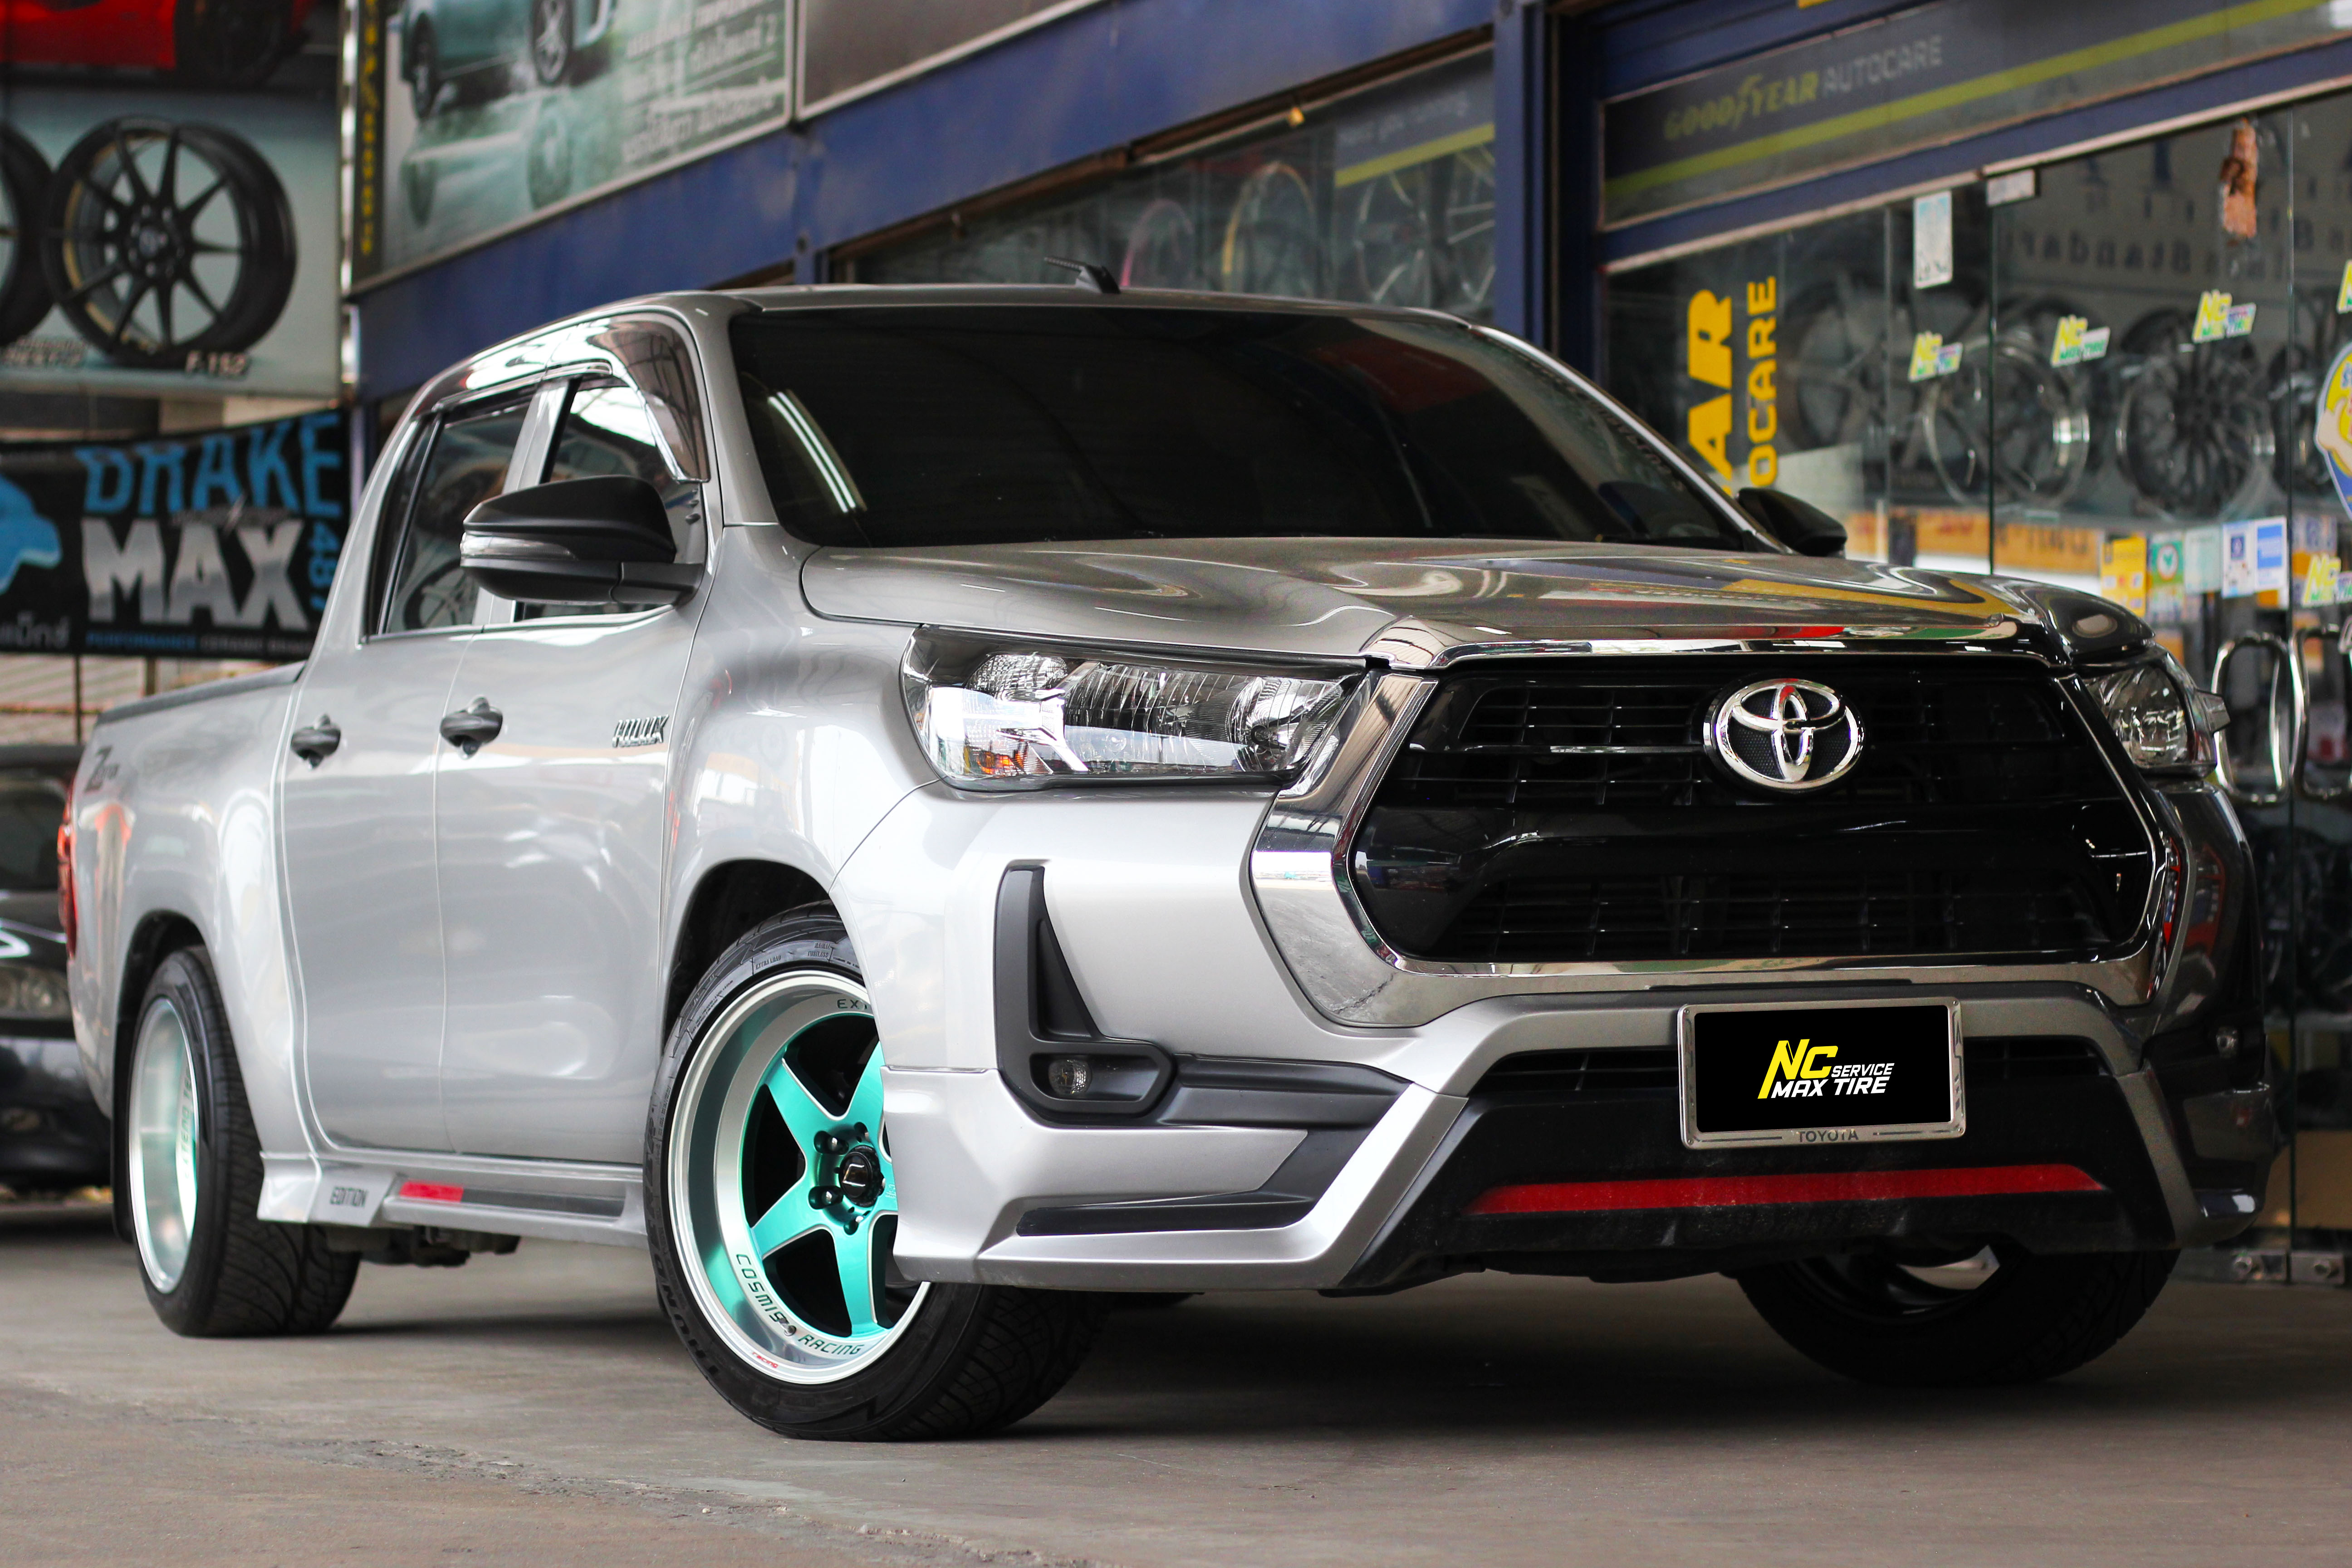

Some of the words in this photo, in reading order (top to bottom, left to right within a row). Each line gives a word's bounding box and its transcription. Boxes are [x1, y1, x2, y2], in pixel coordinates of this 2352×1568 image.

[1662, 73, 1819, 141] GOODYEAR
[1821, 34, 1944, 98] AUTOCARE
[1688, 289, 1732, 497] AR
[1747, 276, 1777, 487] OCARE
[81, 516, 309, 632] MAX
[1798, 1129, 1859, 1142] TOYOTA
[329, 1186, 368, 1207] EDITION
[736, 1254, 789, 1326] COSMIS
[798, 1334, 865, 1355] RACING
[752, 1351, 779, 1369] racing
